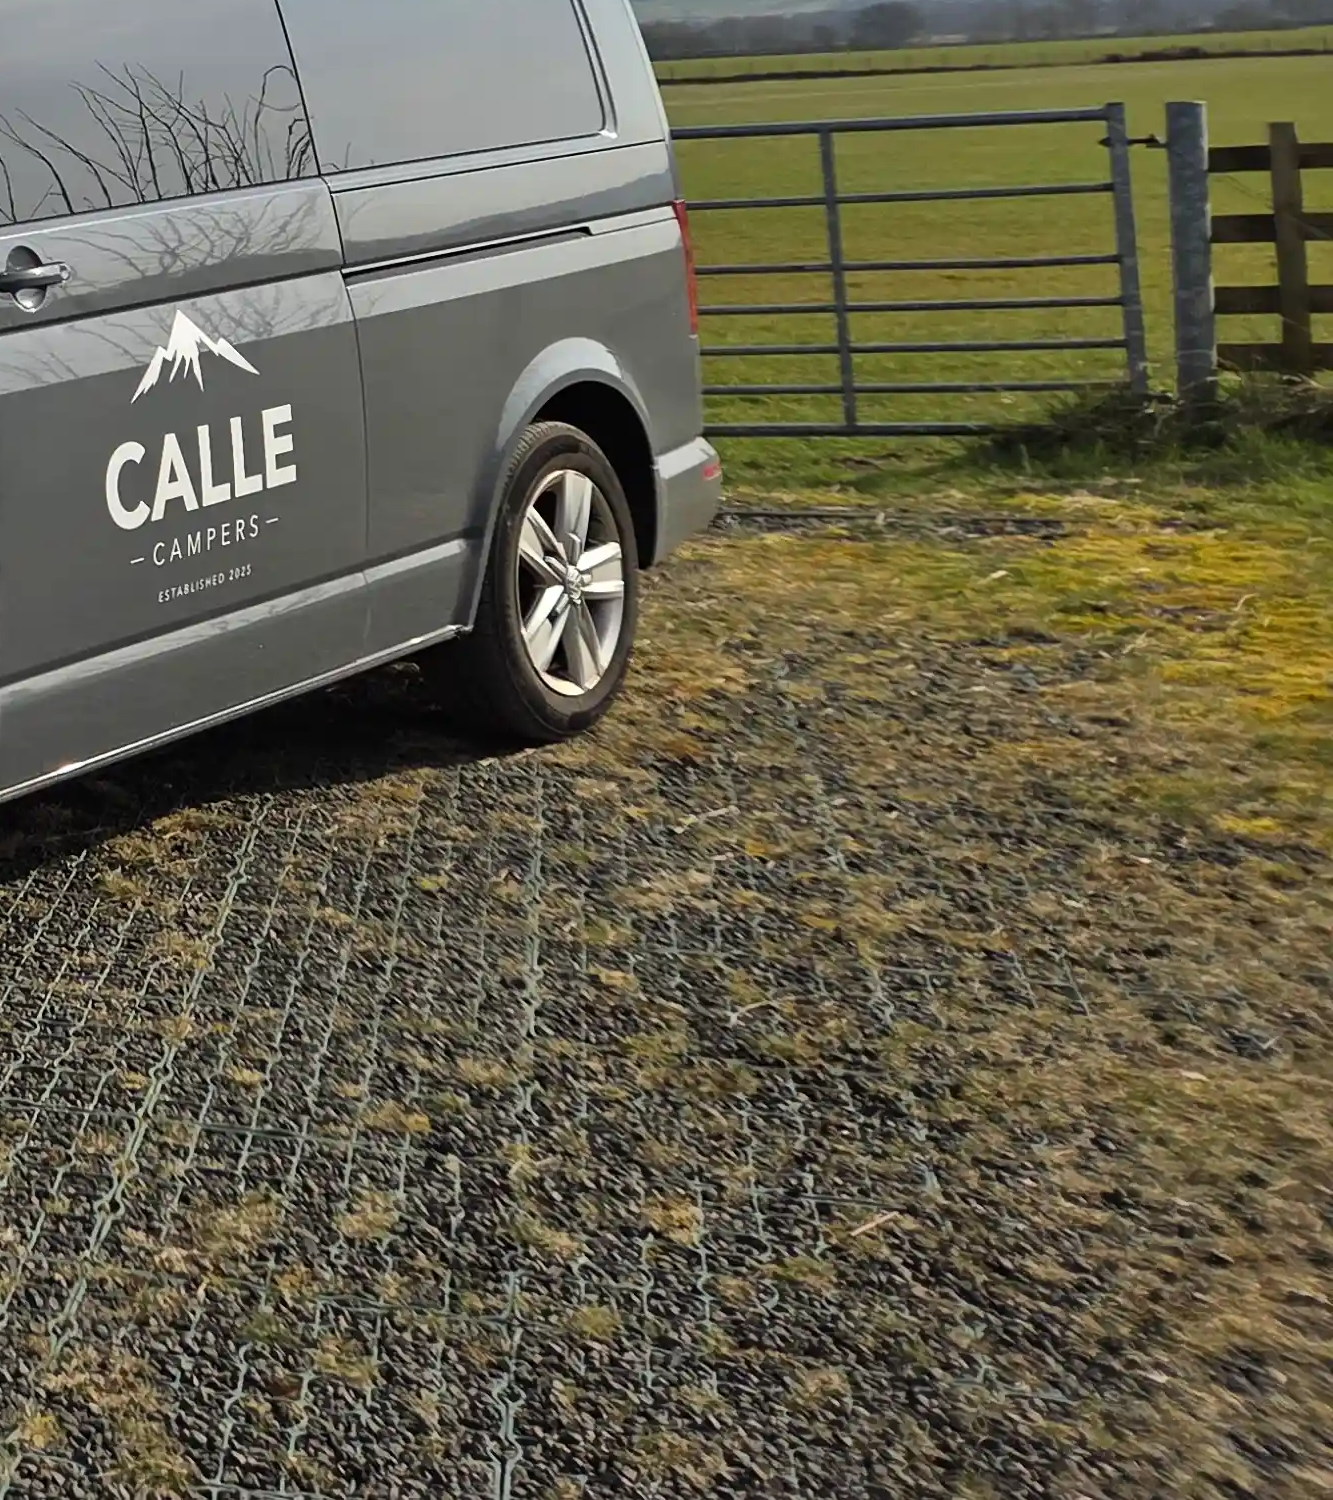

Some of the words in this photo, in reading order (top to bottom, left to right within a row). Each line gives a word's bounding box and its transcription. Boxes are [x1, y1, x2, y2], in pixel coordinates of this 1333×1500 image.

[105, 403, 297, 531] CALLE
[152, 514, 260, 567] CAMPERS
[157, 572, 225, 603] ESTABLISHED
[228, 563, 253, 581] 2025
